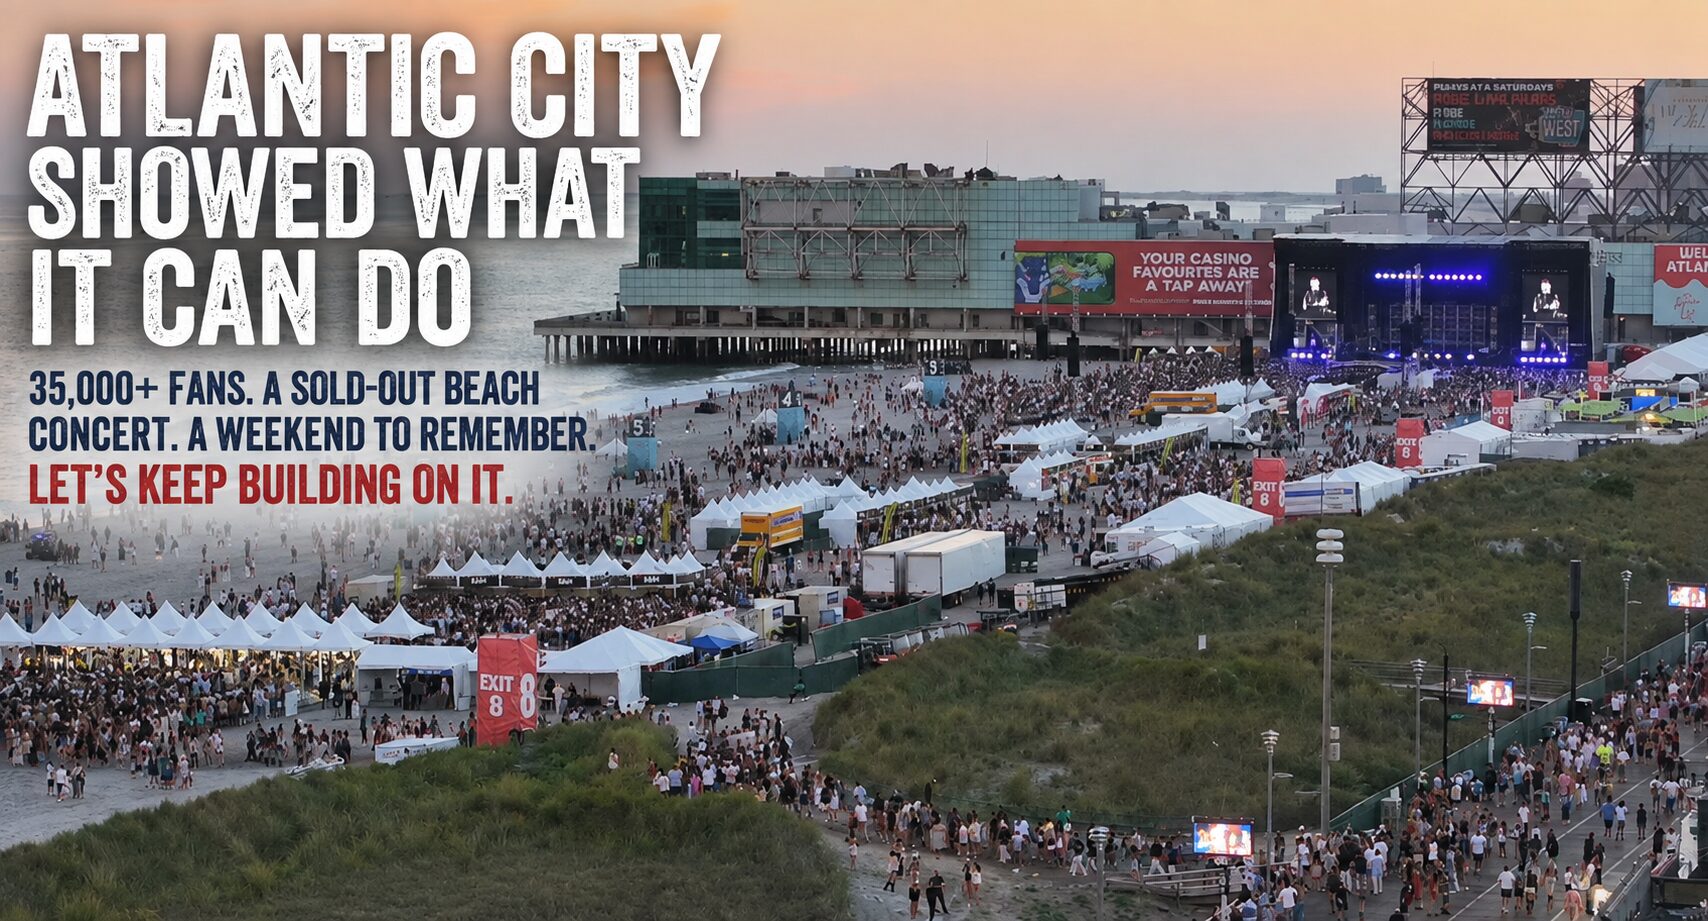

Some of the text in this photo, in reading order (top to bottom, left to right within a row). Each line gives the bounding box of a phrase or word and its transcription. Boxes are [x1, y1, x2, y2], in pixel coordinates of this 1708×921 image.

[1543, 120, 1580, 137] WEST
[1140, 252, 1252, 265] YOUR CASINO
[1227, 266, 1259, 279] ARE
[1145, 280, 1158, 292] A
[1162, 280, 1194, 292] TAP
[781, 391, 792, 407] 4
[633, 419, 644, 436] 5
[1402, 447, 1411, 459] 8
[1253, 481, 1277, 492] EXIT
[1260, 493, 1270, 506] 8
[480, 674, 514, 692] EXIT
[520, 673, 536, 718] 8
[489, 695, 504, 717] 8
